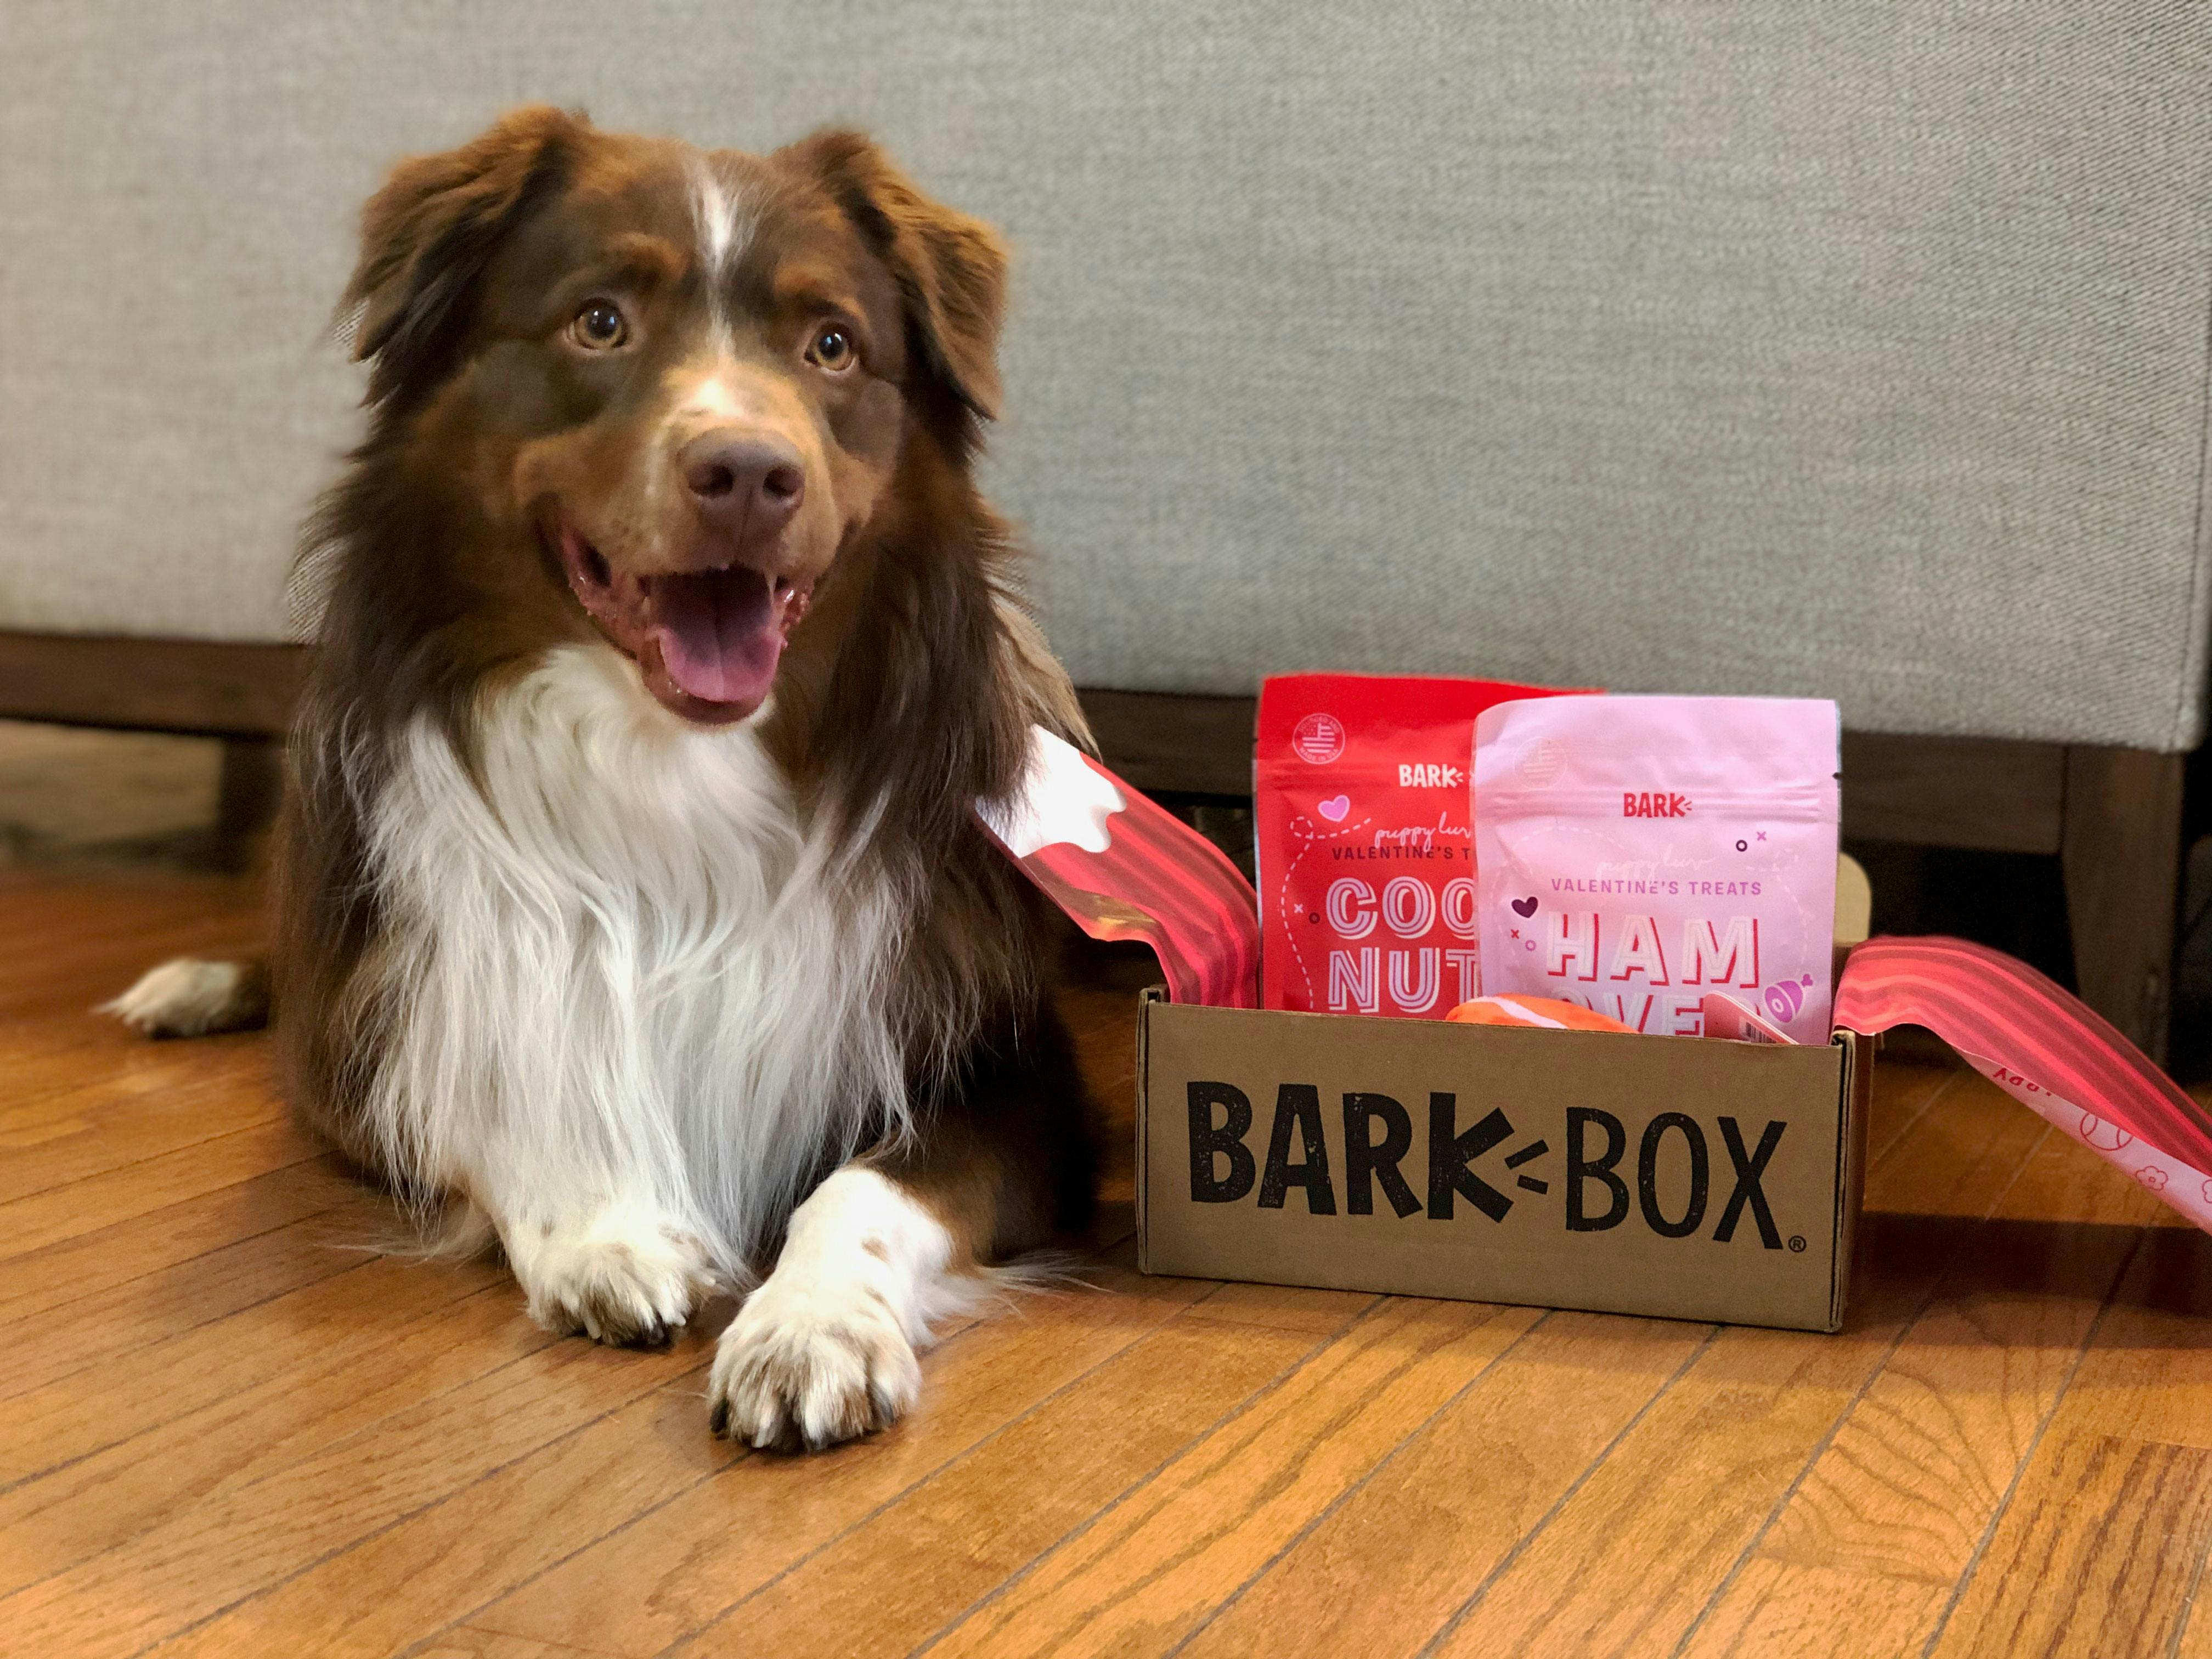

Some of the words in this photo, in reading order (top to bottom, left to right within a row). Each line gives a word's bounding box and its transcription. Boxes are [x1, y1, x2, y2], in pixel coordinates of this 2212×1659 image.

[1399, 763, 1458, 787] BARK
[1623, 793, 1687, 817] BARK
[1374, 827, 1437, 852] puppy
[1332, 845, 1454, 860] VALENTINE'S
[1551, 878, 1679, 894] VALENTINE'S
[1689, 881, 1762, 895] TREATS
[1546, 911, 1759, 989] HAM
[1187, 1081, 1516, 1223] BARK
